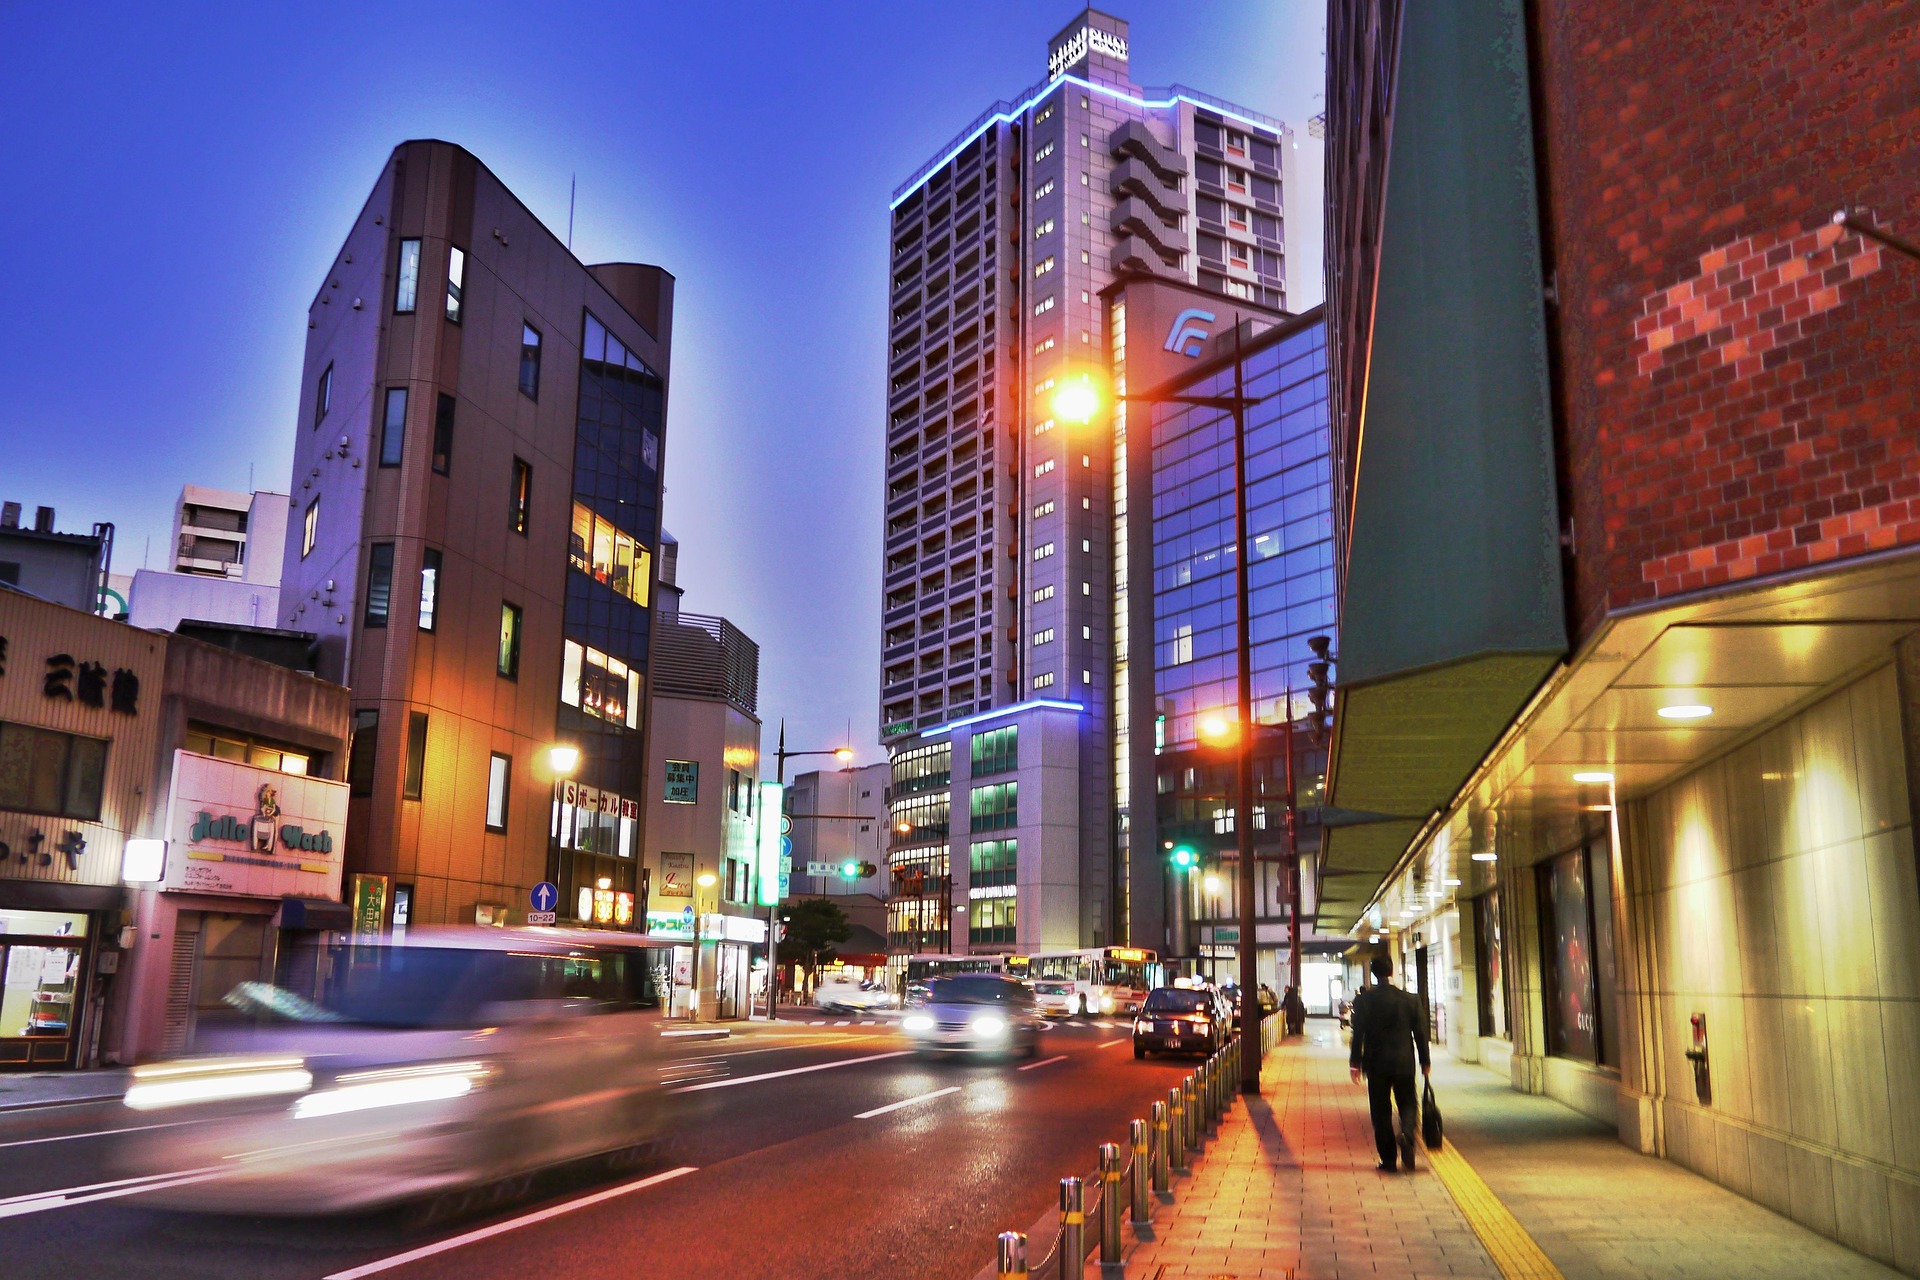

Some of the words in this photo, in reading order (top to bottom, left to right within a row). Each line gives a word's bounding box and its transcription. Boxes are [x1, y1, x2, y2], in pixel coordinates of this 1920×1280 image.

[190, 812, 249, 842] Hello
[280, 824, 332, 853] Wash
[529, 914, 554, 922] 10-22
